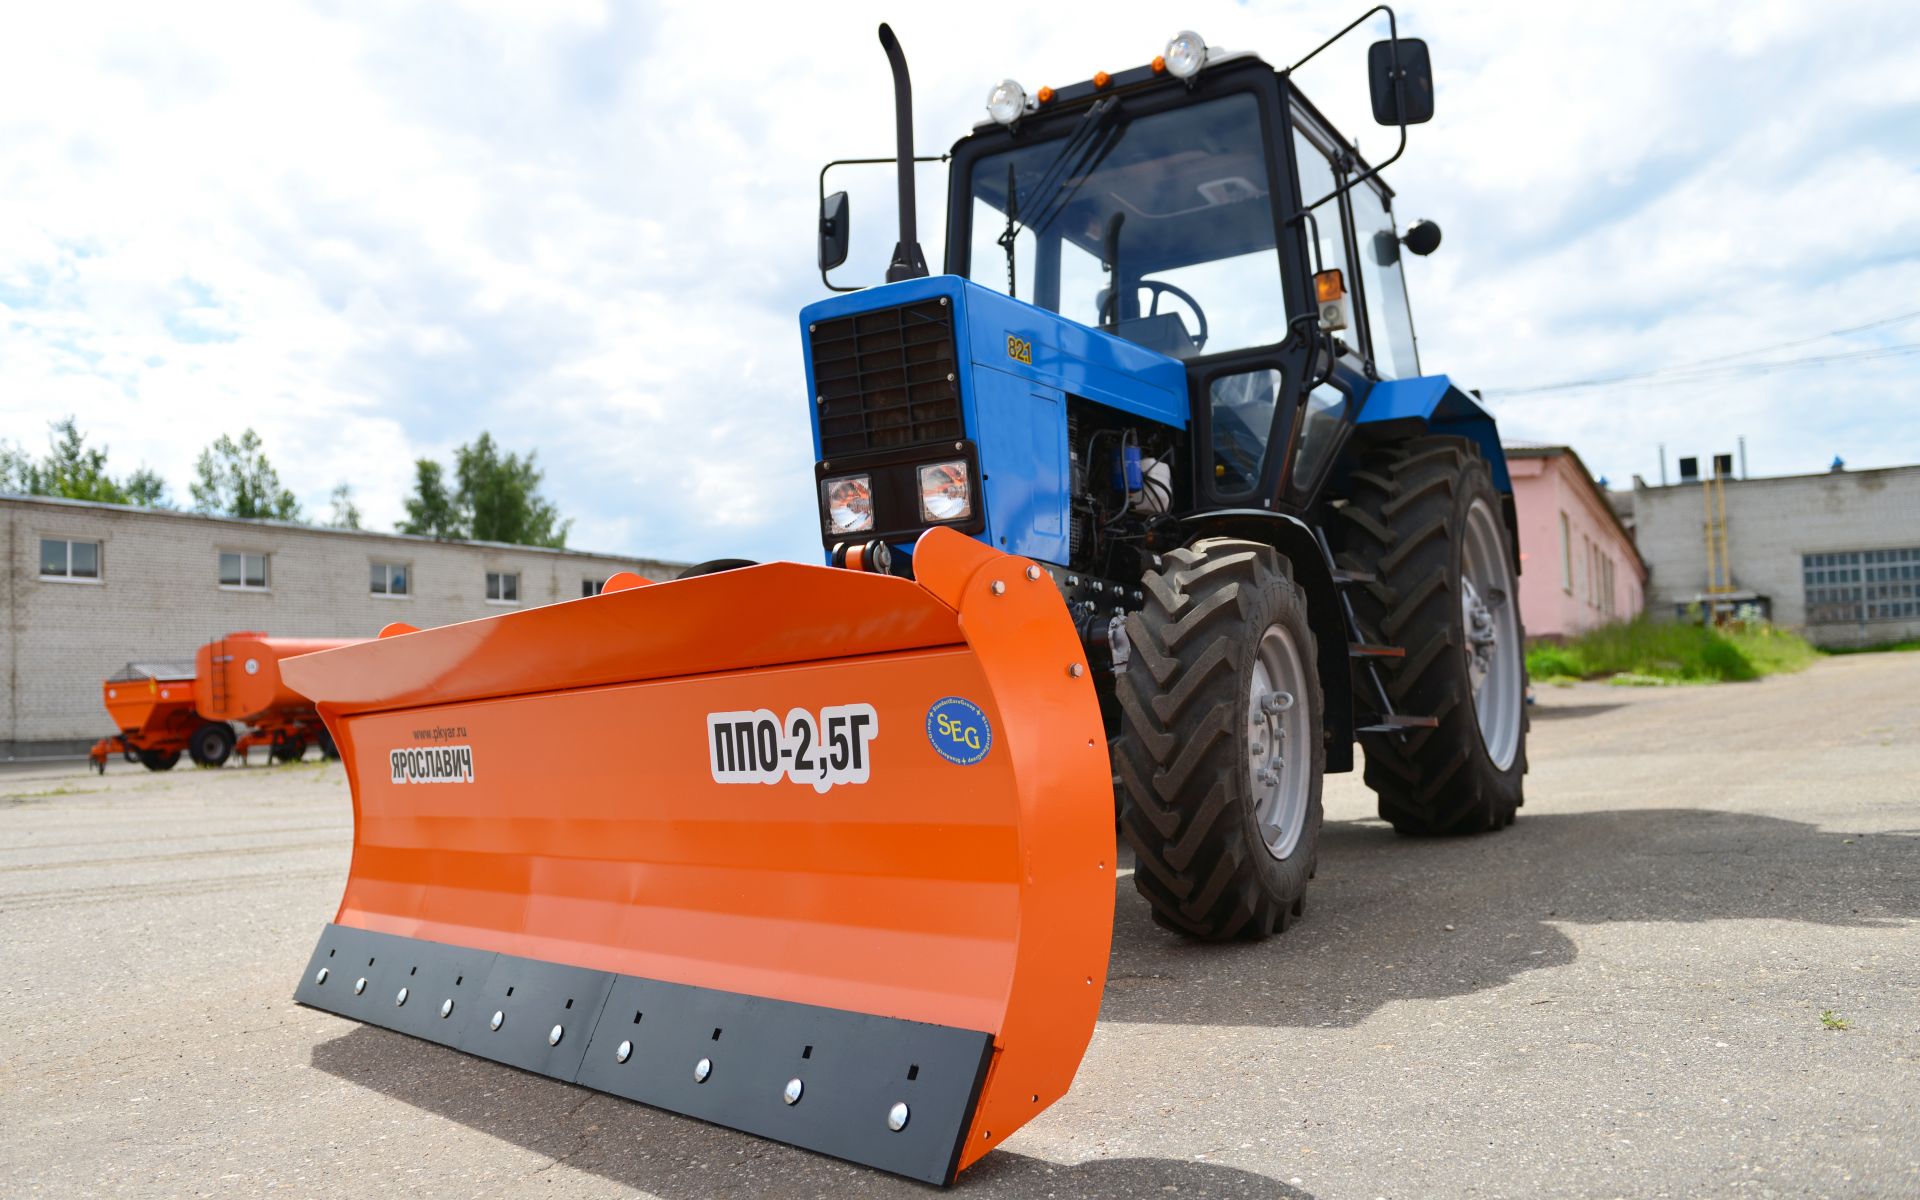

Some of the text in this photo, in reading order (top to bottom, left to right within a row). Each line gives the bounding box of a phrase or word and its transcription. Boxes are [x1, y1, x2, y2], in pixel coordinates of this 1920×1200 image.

[412, 726, 467, 742] www.pkyar.ru
[714, 714, 870, 780] ППО-2,5Г
[937, 713, 980, 749] SEG
[391, 748, 472, 779] ЯРОСЛАВИЧ
